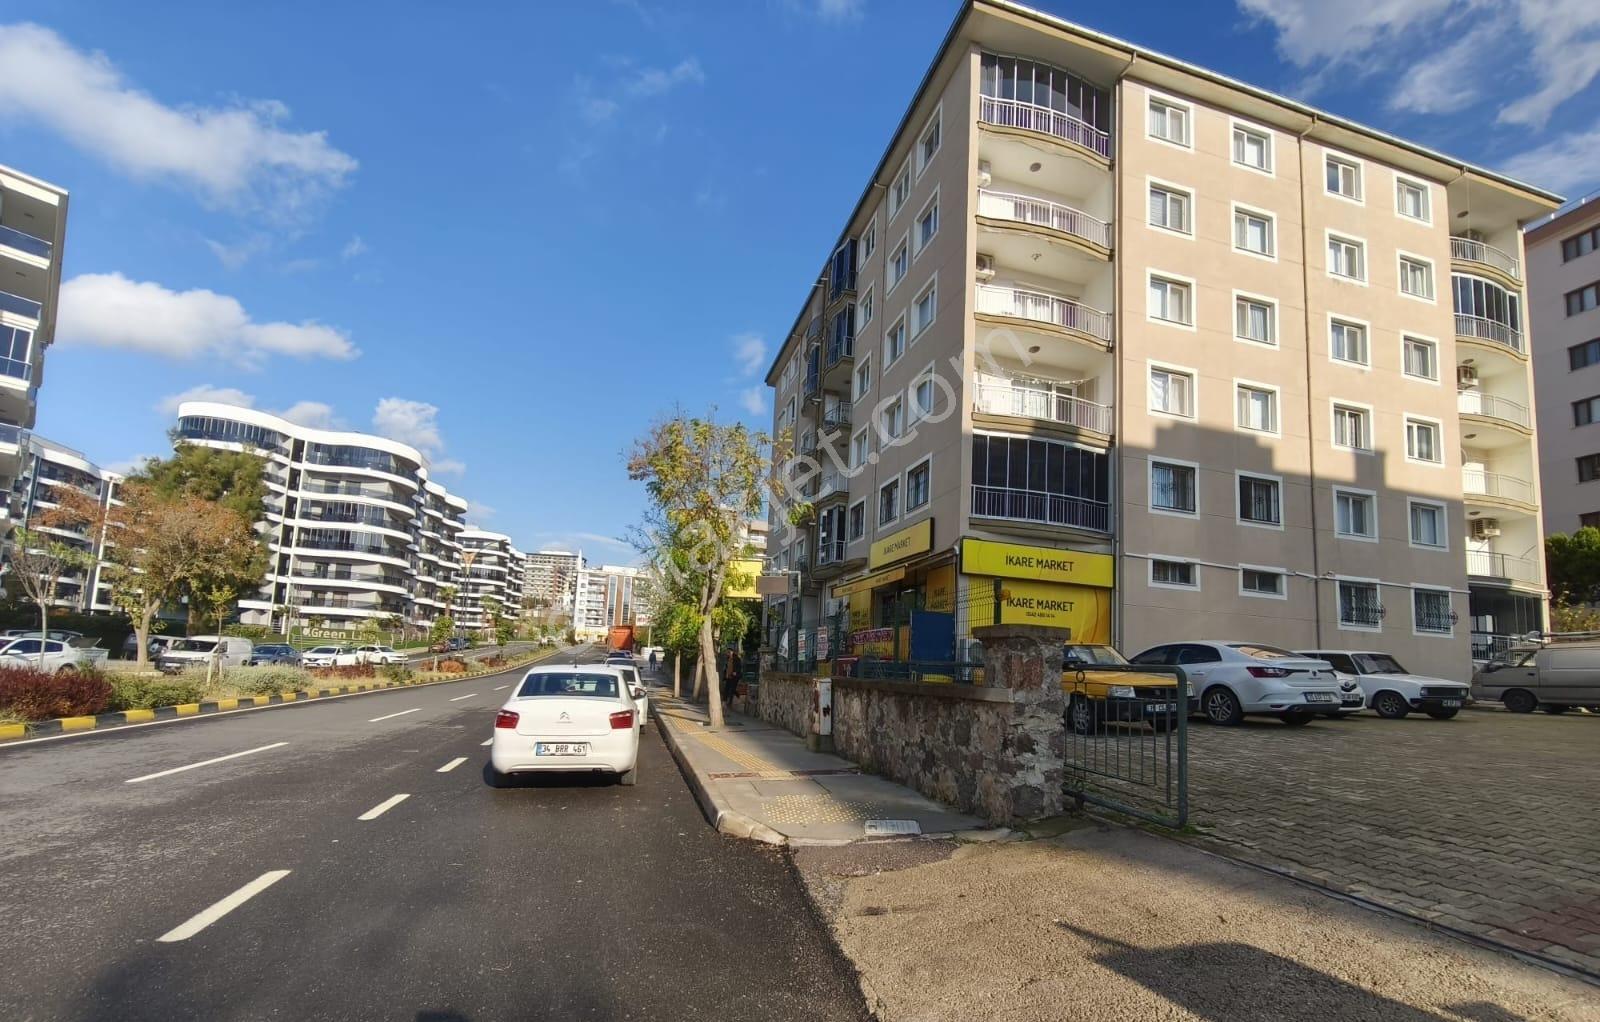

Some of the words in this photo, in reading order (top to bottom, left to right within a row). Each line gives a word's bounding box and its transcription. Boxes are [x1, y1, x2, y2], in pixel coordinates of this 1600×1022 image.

[1036, 558, 1075, 572] MARKET
[1036, 599, 1075, 612] MARKET
[311, 627, 347, 640] Green
[543, 744, 551, 753] 34
[555, 744, 569, 753] BRR
